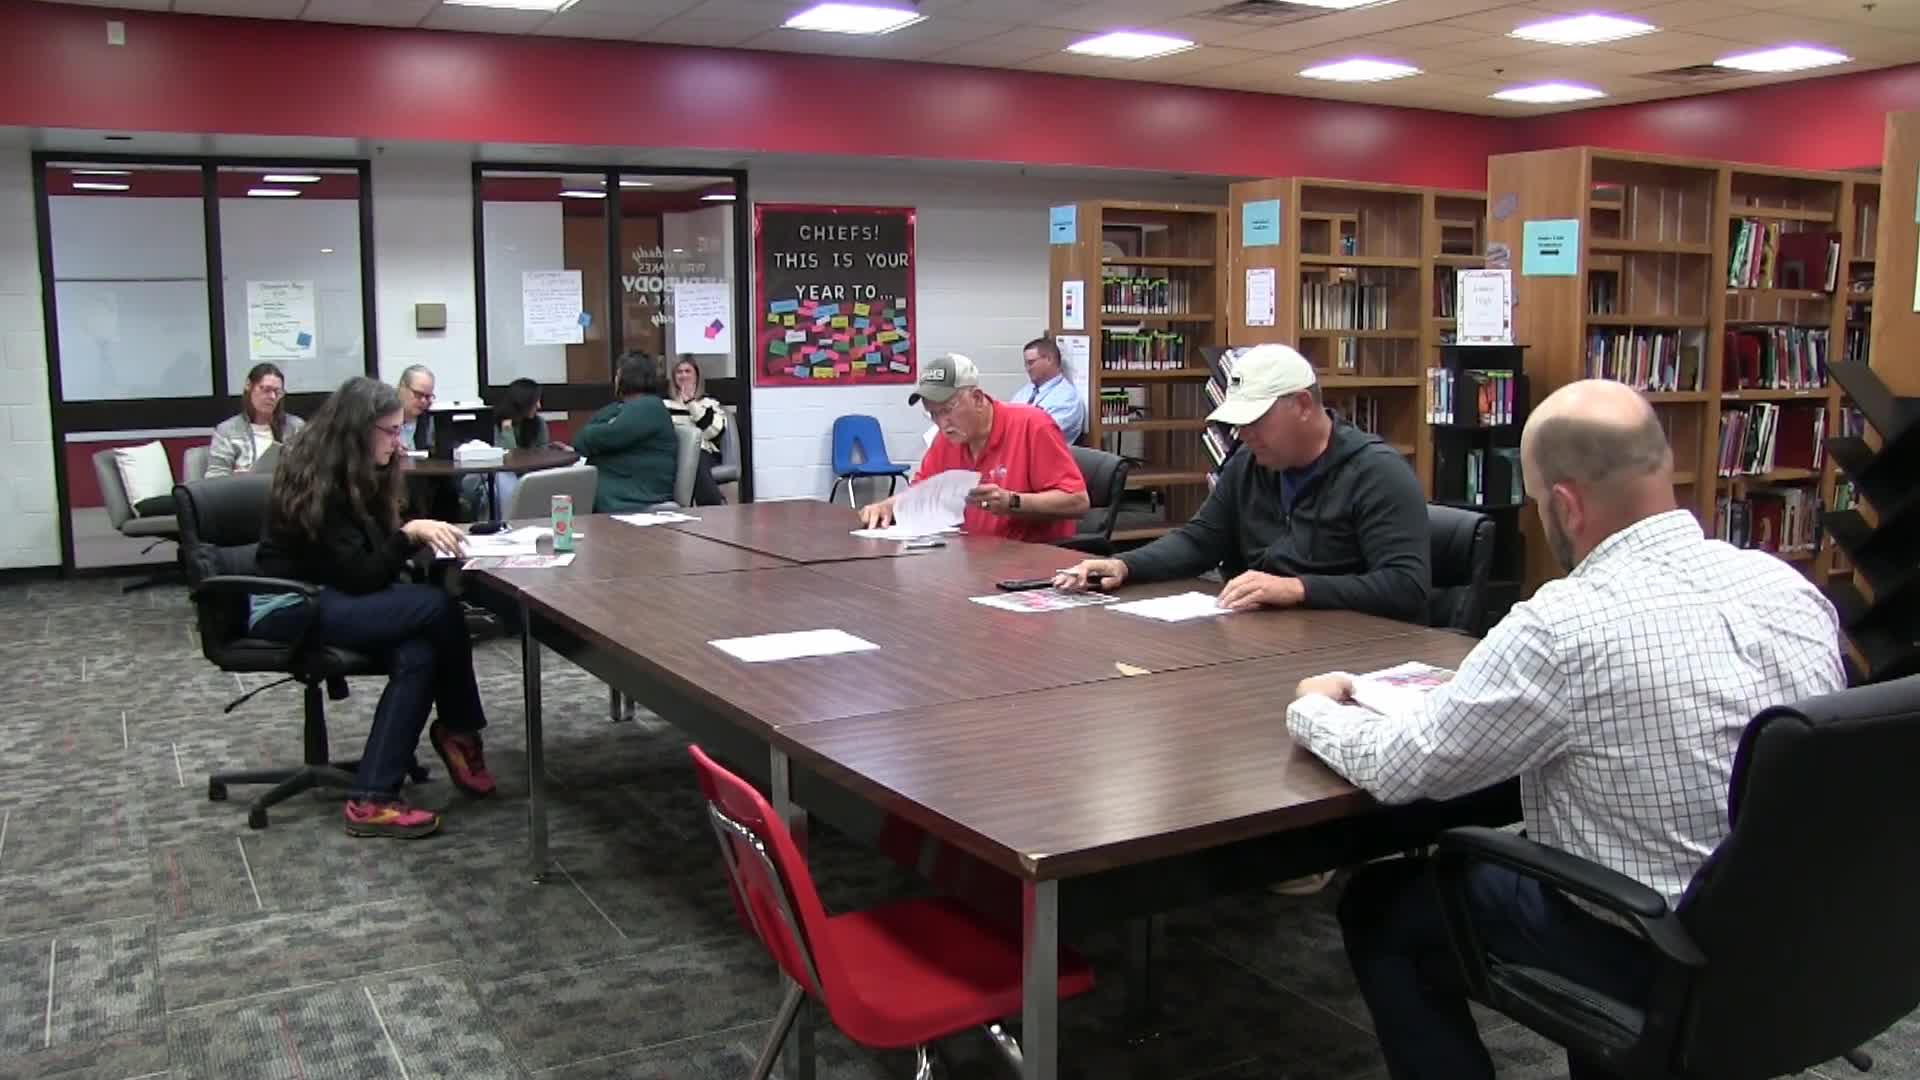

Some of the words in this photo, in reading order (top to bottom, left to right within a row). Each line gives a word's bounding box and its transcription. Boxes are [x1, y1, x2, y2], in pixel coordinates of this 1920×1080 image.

[799, 225, 879, 241] CHIEFS!
[773, 252, 818, 268] THIS
[832, 252, 853, 268] IS
[865, 252, 909, 268] YOUR
[795, 285, 845, 300] YEAR
[852, 285, 893, 300] TO...
